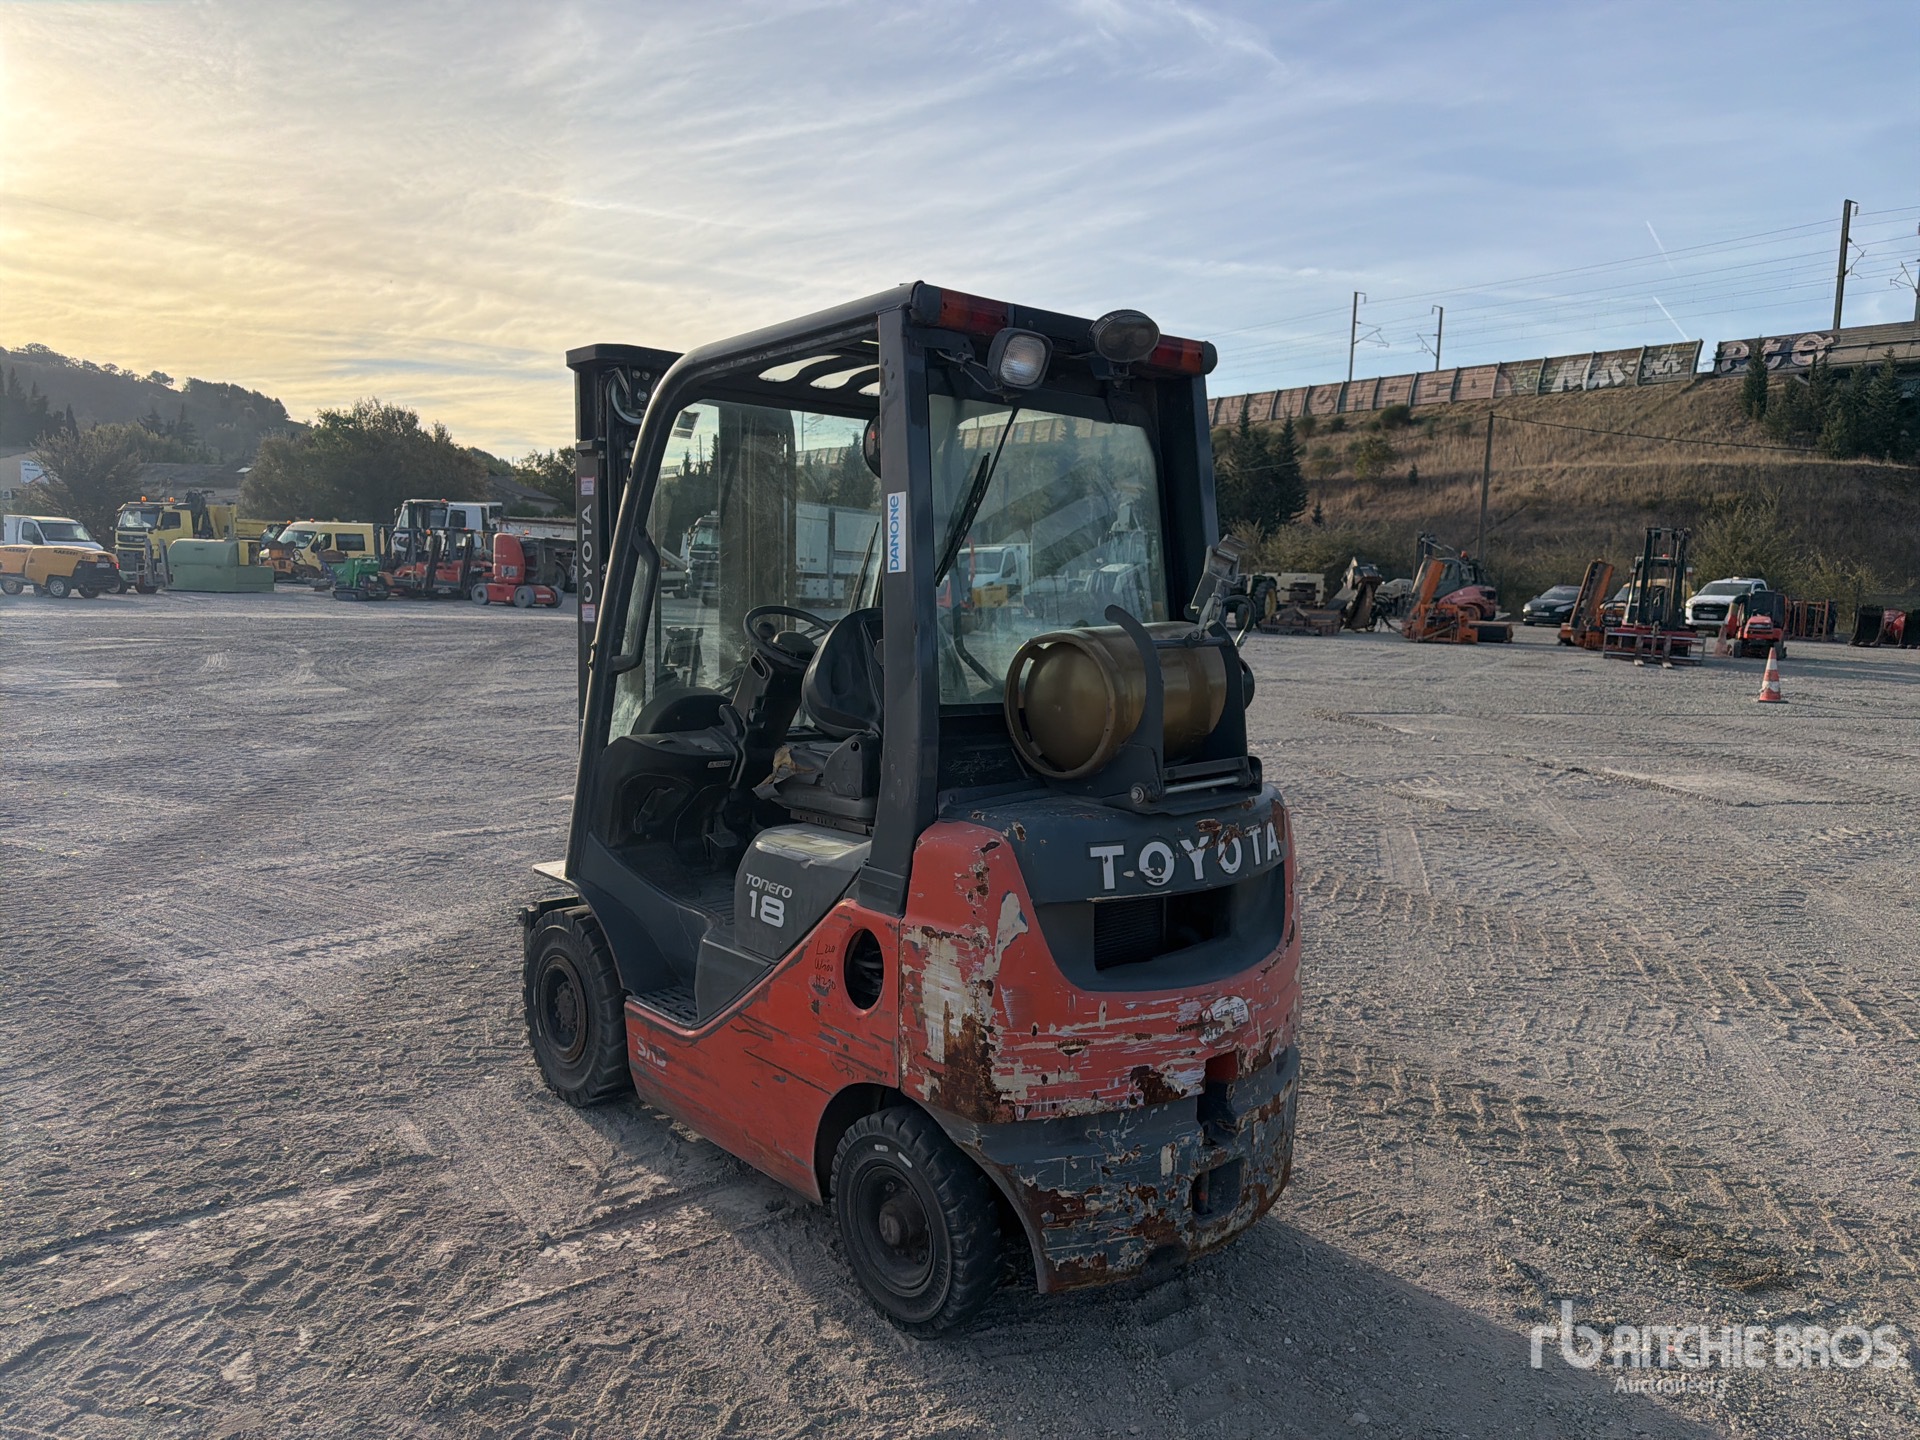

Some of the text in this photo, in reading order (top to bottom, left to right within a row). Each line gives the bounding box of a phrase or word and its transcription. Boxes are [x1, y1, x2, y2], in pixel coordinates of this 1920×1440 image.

[582, 504, 593, 602] OYOTA
[1090, 822, 1280, 890] TOYOTA
[746, 873, 793, 899] TONERO
[749, 890, 785, 928] 18
